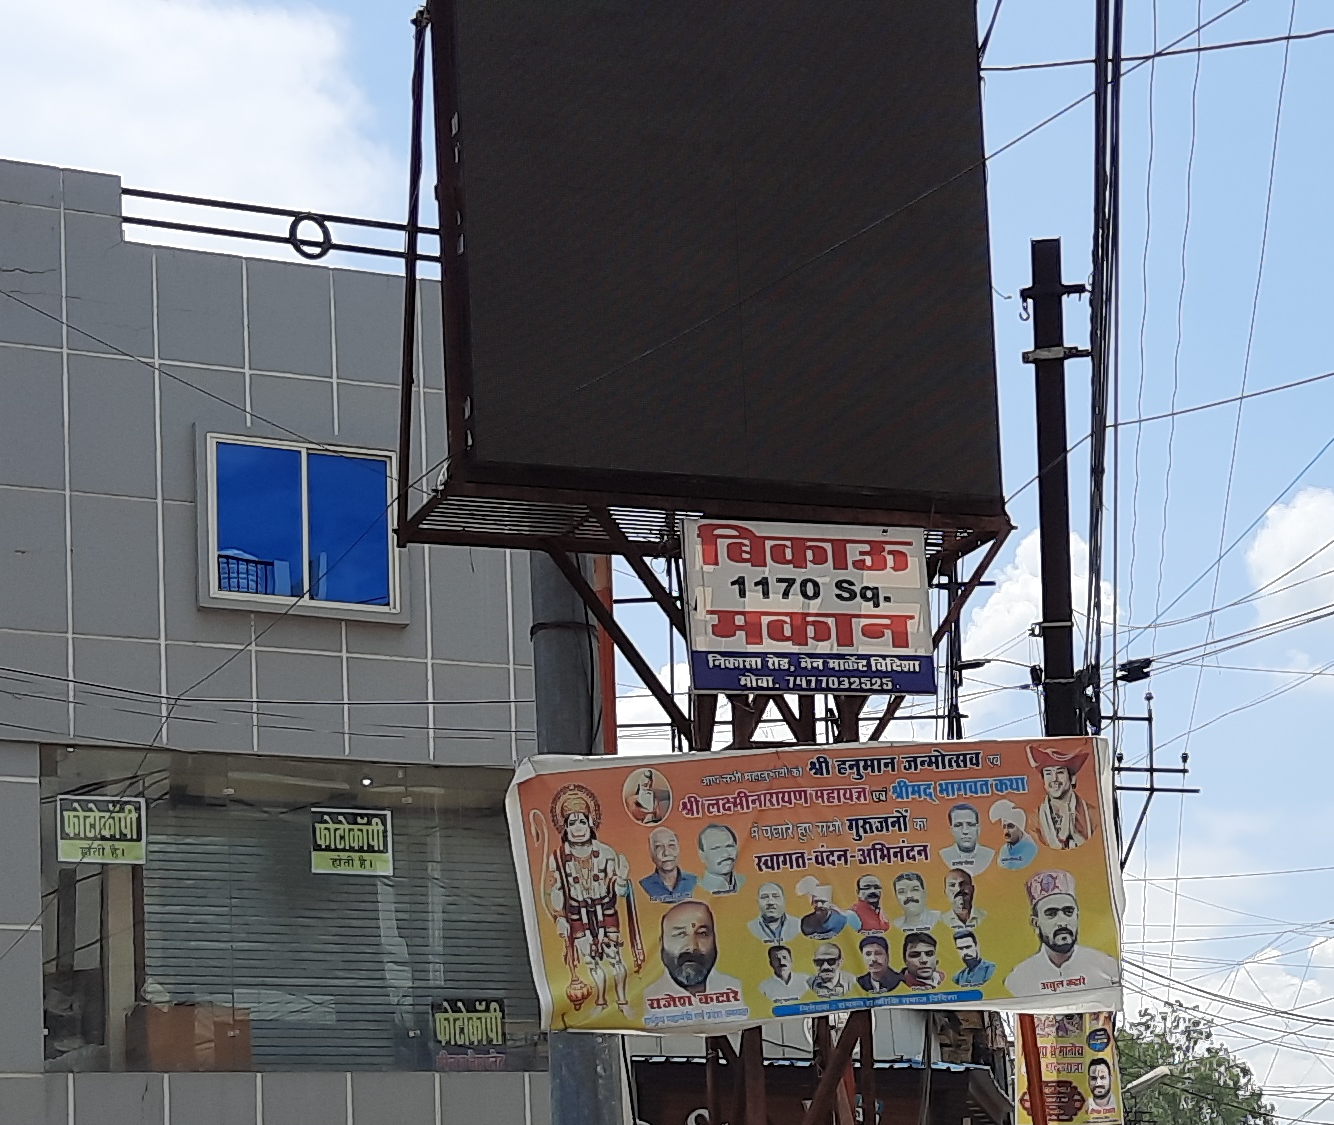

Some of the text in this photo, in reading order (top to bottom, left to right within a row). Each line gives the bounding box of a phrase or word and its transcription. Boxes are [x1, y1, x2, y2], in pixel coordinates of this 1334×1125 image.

[697, 523, 914, 572] बिकाऊ
[730, 576, 892, 608] 1170 Sq.
[706, 609, 916, 648] मकान
[708, 654, 762, 670] निकासा
[871, 657, 920, 672] विदिशा
[785, 676, 893, 690] 7477032525
[809, 756, 830, 776] श्री
[836, 754, 896, 779] हनुमान
[901, 749, 982, 773] जन्मोत्सव
[680, 795, 701, 817] श्री
[703, 790, 809, 815] लक्ष्मीनारायण
[810, 786, 868, 806] महायज्ञ
[891, 781, 936, 803] श्रीमद्
[938, 778, 991, 800] भागवत
[994, 775, 1028, 794] कथा
[63, 798, 139, 838] फोटोकॉपी
[315, 815, 386, 849] फोटोकॉपी
[647, 988, 740, 1010] राजेश कटारे
[435, 1000, 504, 1047] फोटोकॉपी
